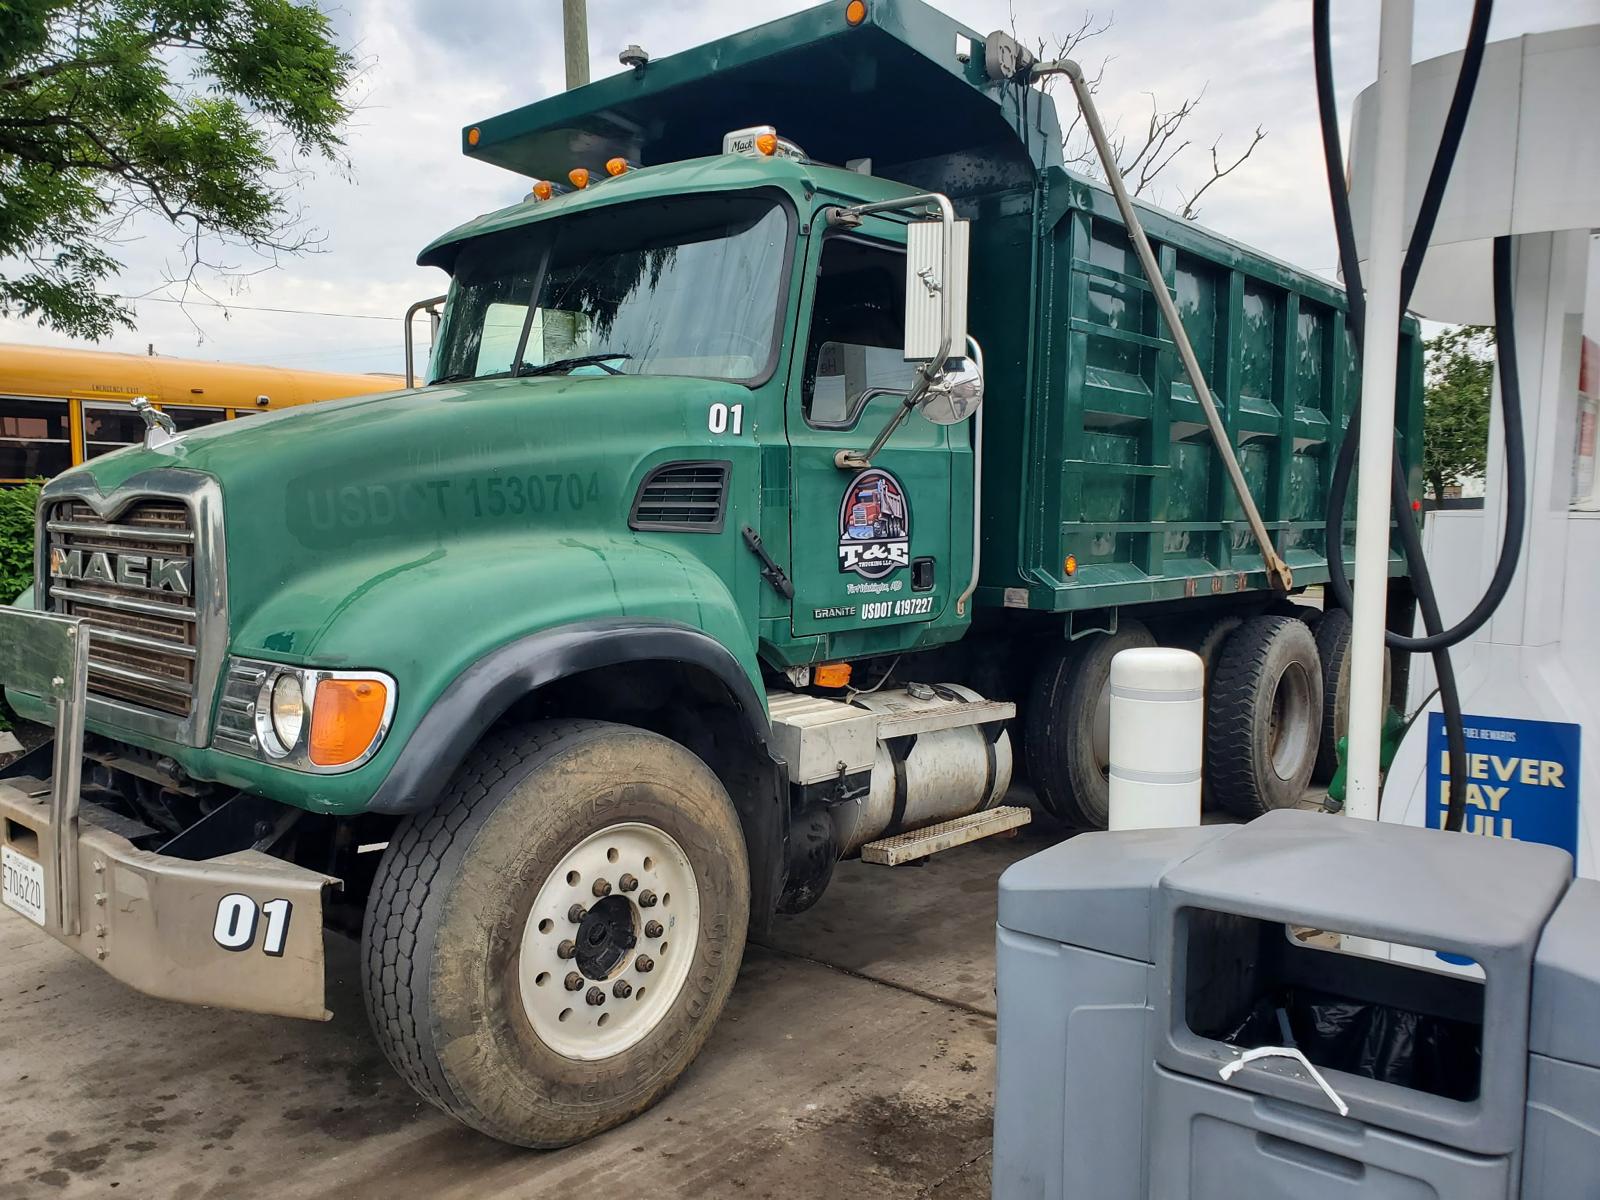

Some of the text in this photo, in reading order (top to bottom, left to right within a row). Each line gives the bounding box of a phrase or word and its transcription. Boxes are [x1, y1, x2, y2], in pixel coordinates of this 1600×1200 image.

[731, 140, 753, 153] Mack
[708, 402, 744, 436] 01
[465, 471, 602, 518] 1530704
[51, 546, 192, 596] MACK
[814, 606, 856, 619] GRANITE
[861, 597, 933, 620] USDOT 4197227
[1462, 727, 1480, 739] FUEL
[1480, 729, 1517, 742] REWARDS
[3, 863, 41, 909] E70622D
[212, 892, 293, 958] 01
